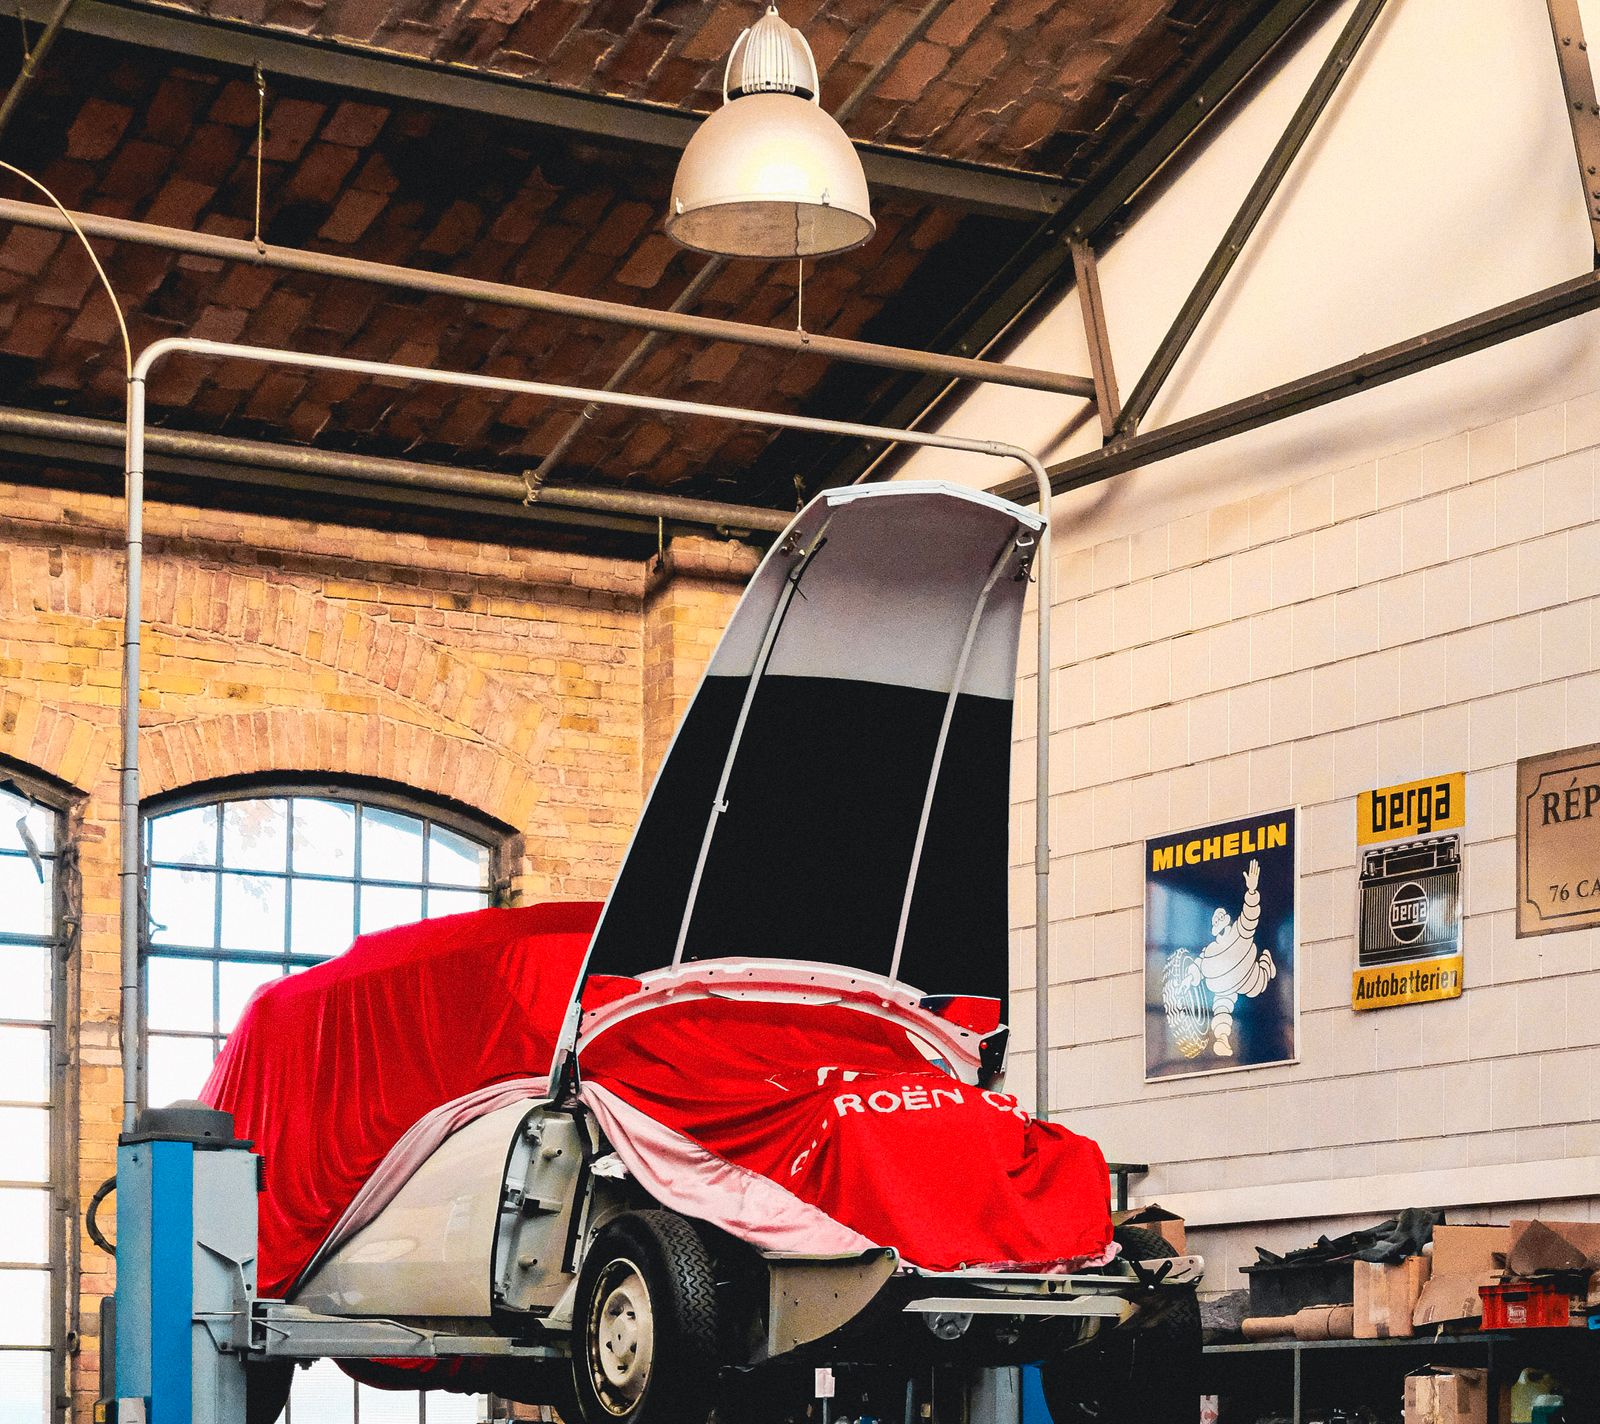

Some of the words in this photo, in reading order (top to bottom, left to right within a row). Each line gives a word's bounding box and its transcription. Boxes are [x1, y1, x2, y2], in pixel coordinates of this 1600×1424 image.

[1372, 783, 1450, 835] berga
[1152, 822, 1287, 872] MICHELIN
[1549, 883, 1570, 902] 76
[1392, 900, 1427, 925] berga
[1356, 967, 1458, 1001] Autobatterien
